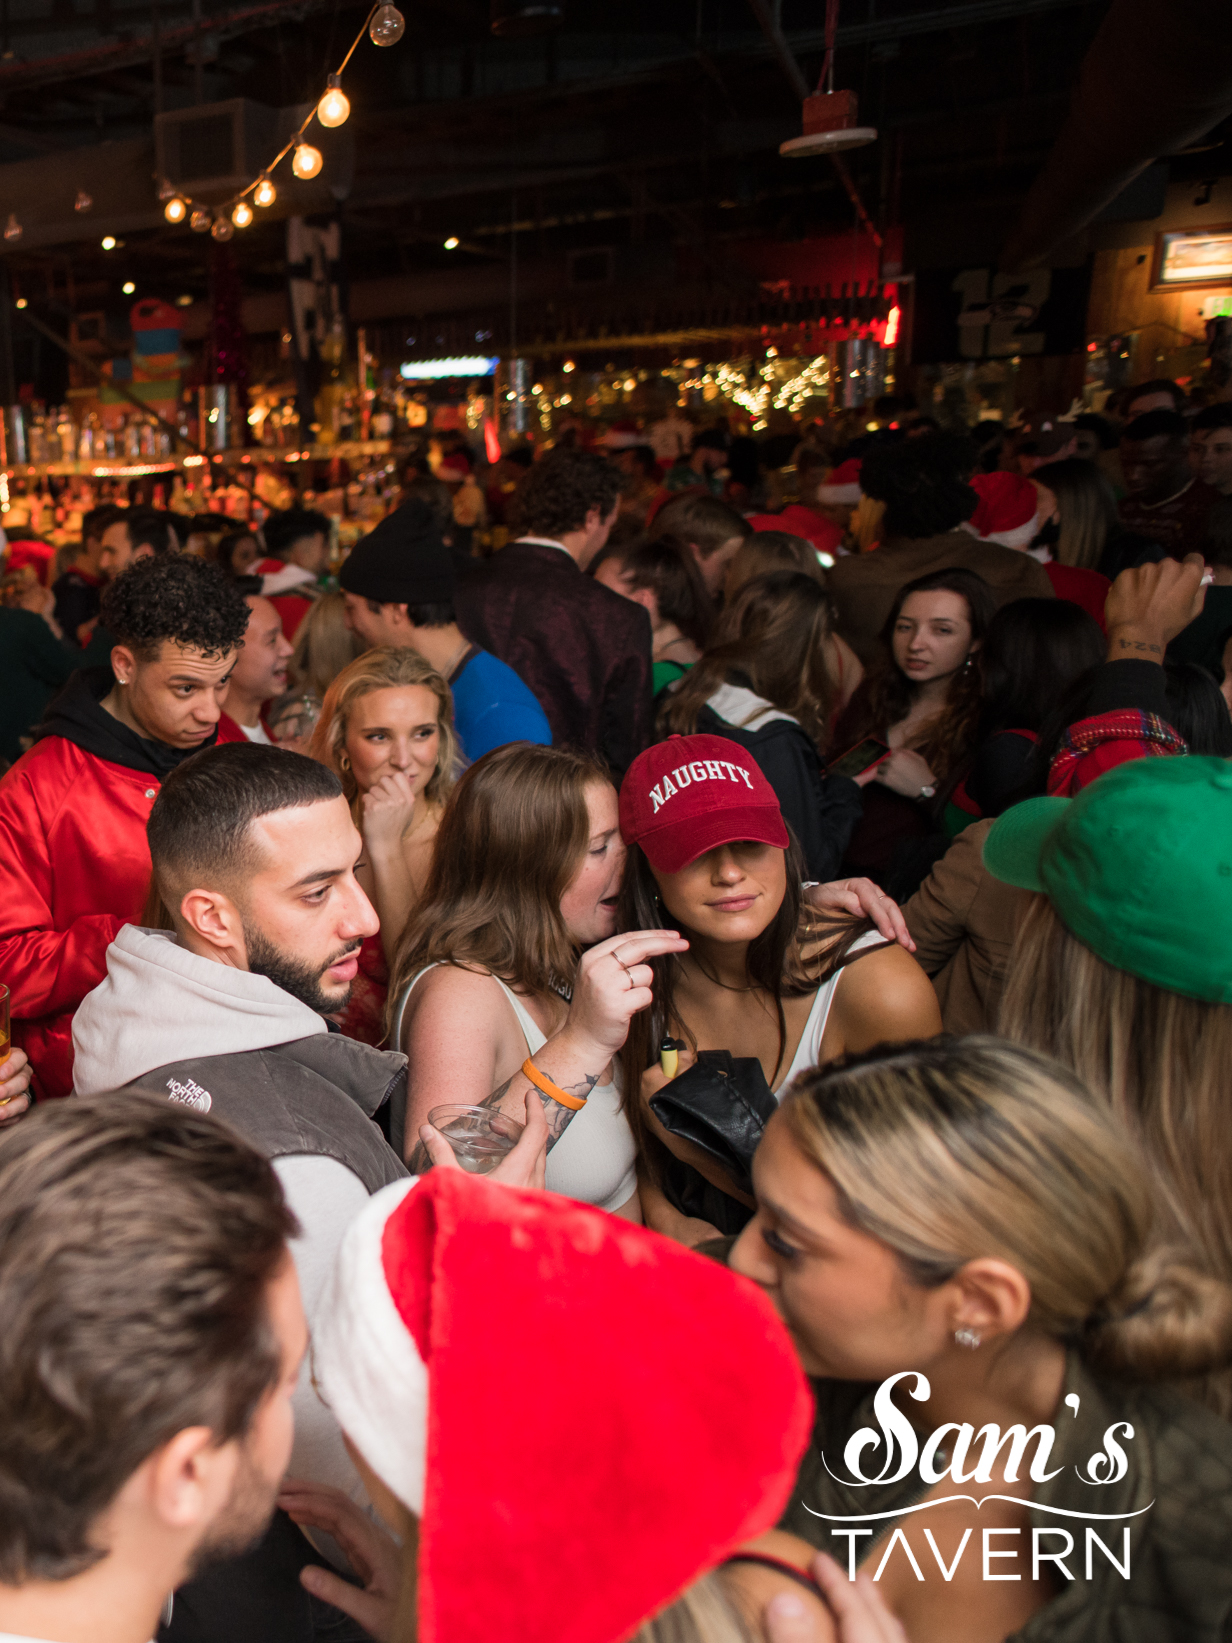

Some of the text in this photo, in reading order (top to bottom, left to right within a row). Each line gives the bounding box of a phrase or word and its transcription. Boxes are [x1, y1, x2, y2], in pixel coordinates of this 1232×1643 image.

[648, 760, 754, 814] NAUGHTY
[166, 1077, 197, 1106] NORTH
[185, 1078, 205, 1097] THE
